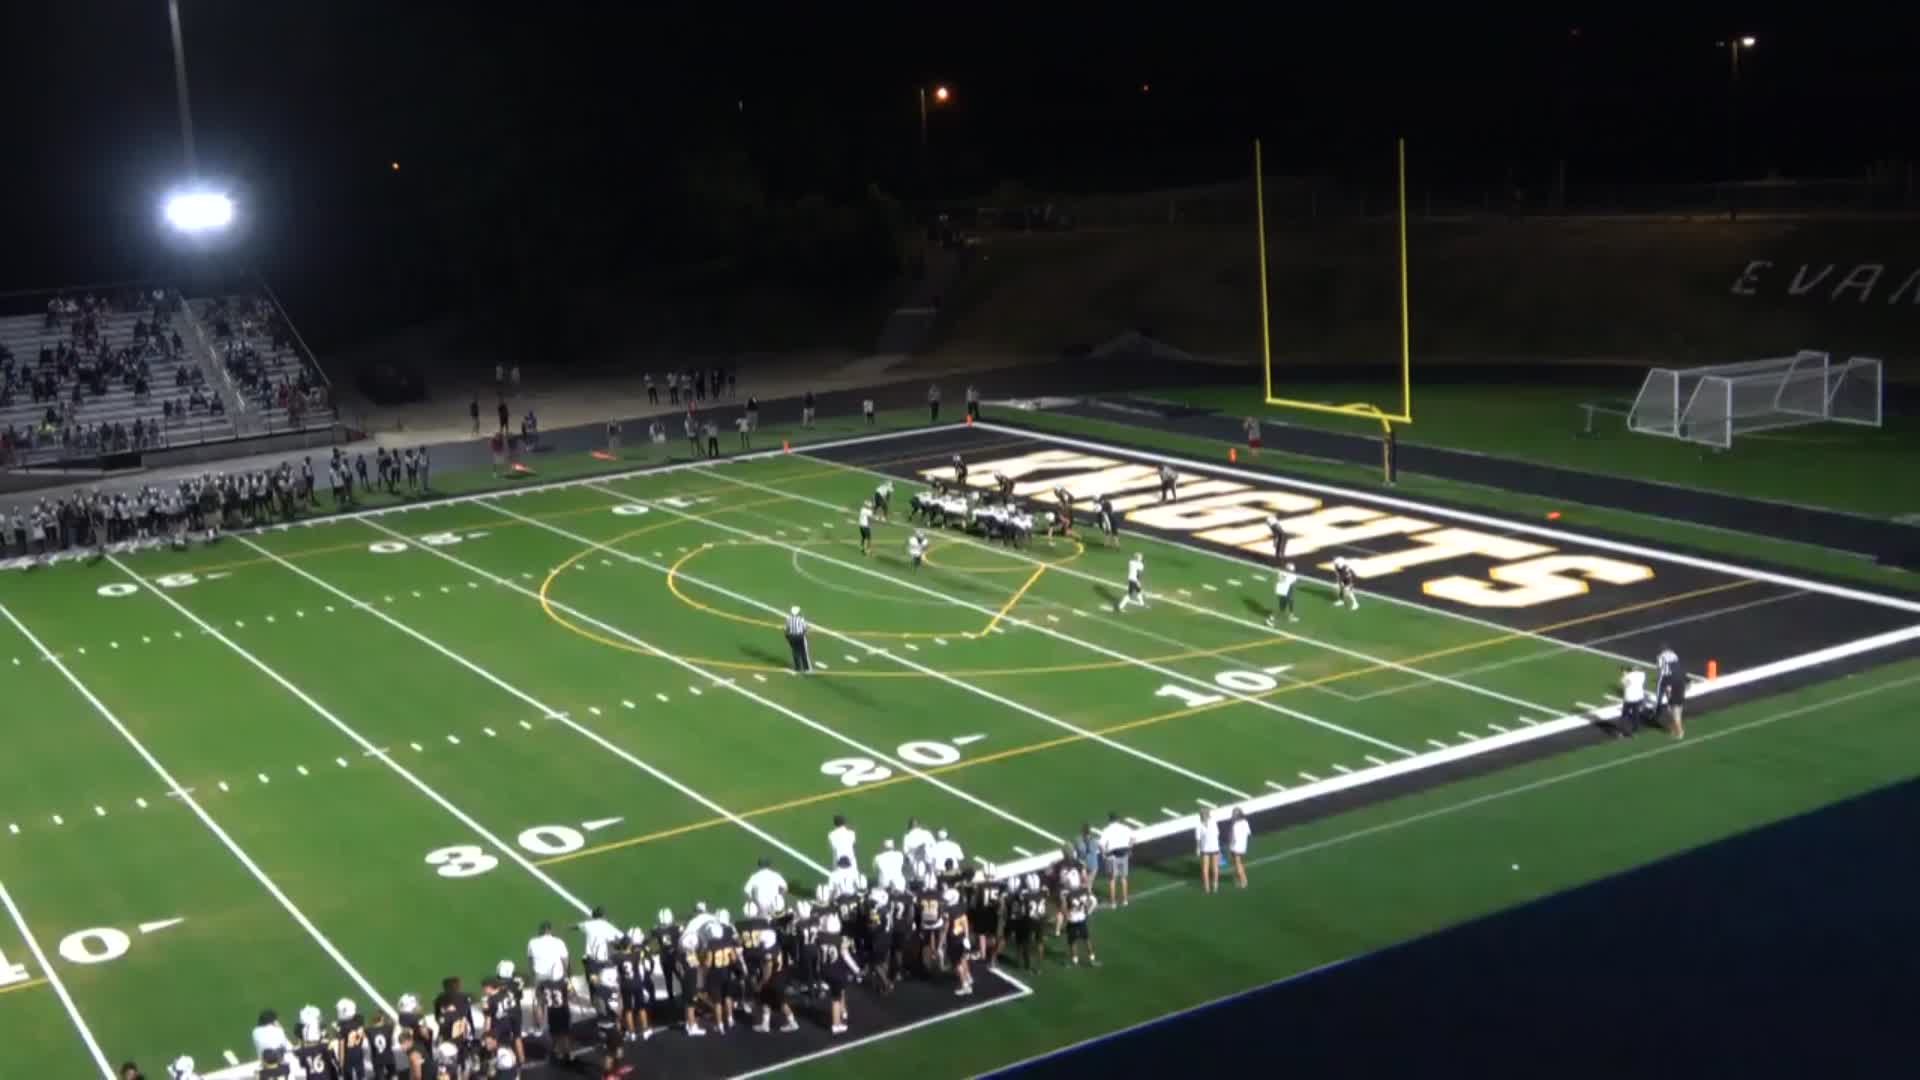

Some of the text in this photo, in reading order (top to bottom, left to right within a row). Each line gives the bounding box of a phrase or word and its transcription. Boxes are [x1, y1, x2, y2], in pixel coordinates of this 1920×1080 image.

[918, 449, 1655, 608] KNIGHTS
[1154, 670, 1277, 708] 10
[820, 740, 960, 787] 20
[424, 825, 585, 877] 30
[374, 1033, 387, 1054] 9
